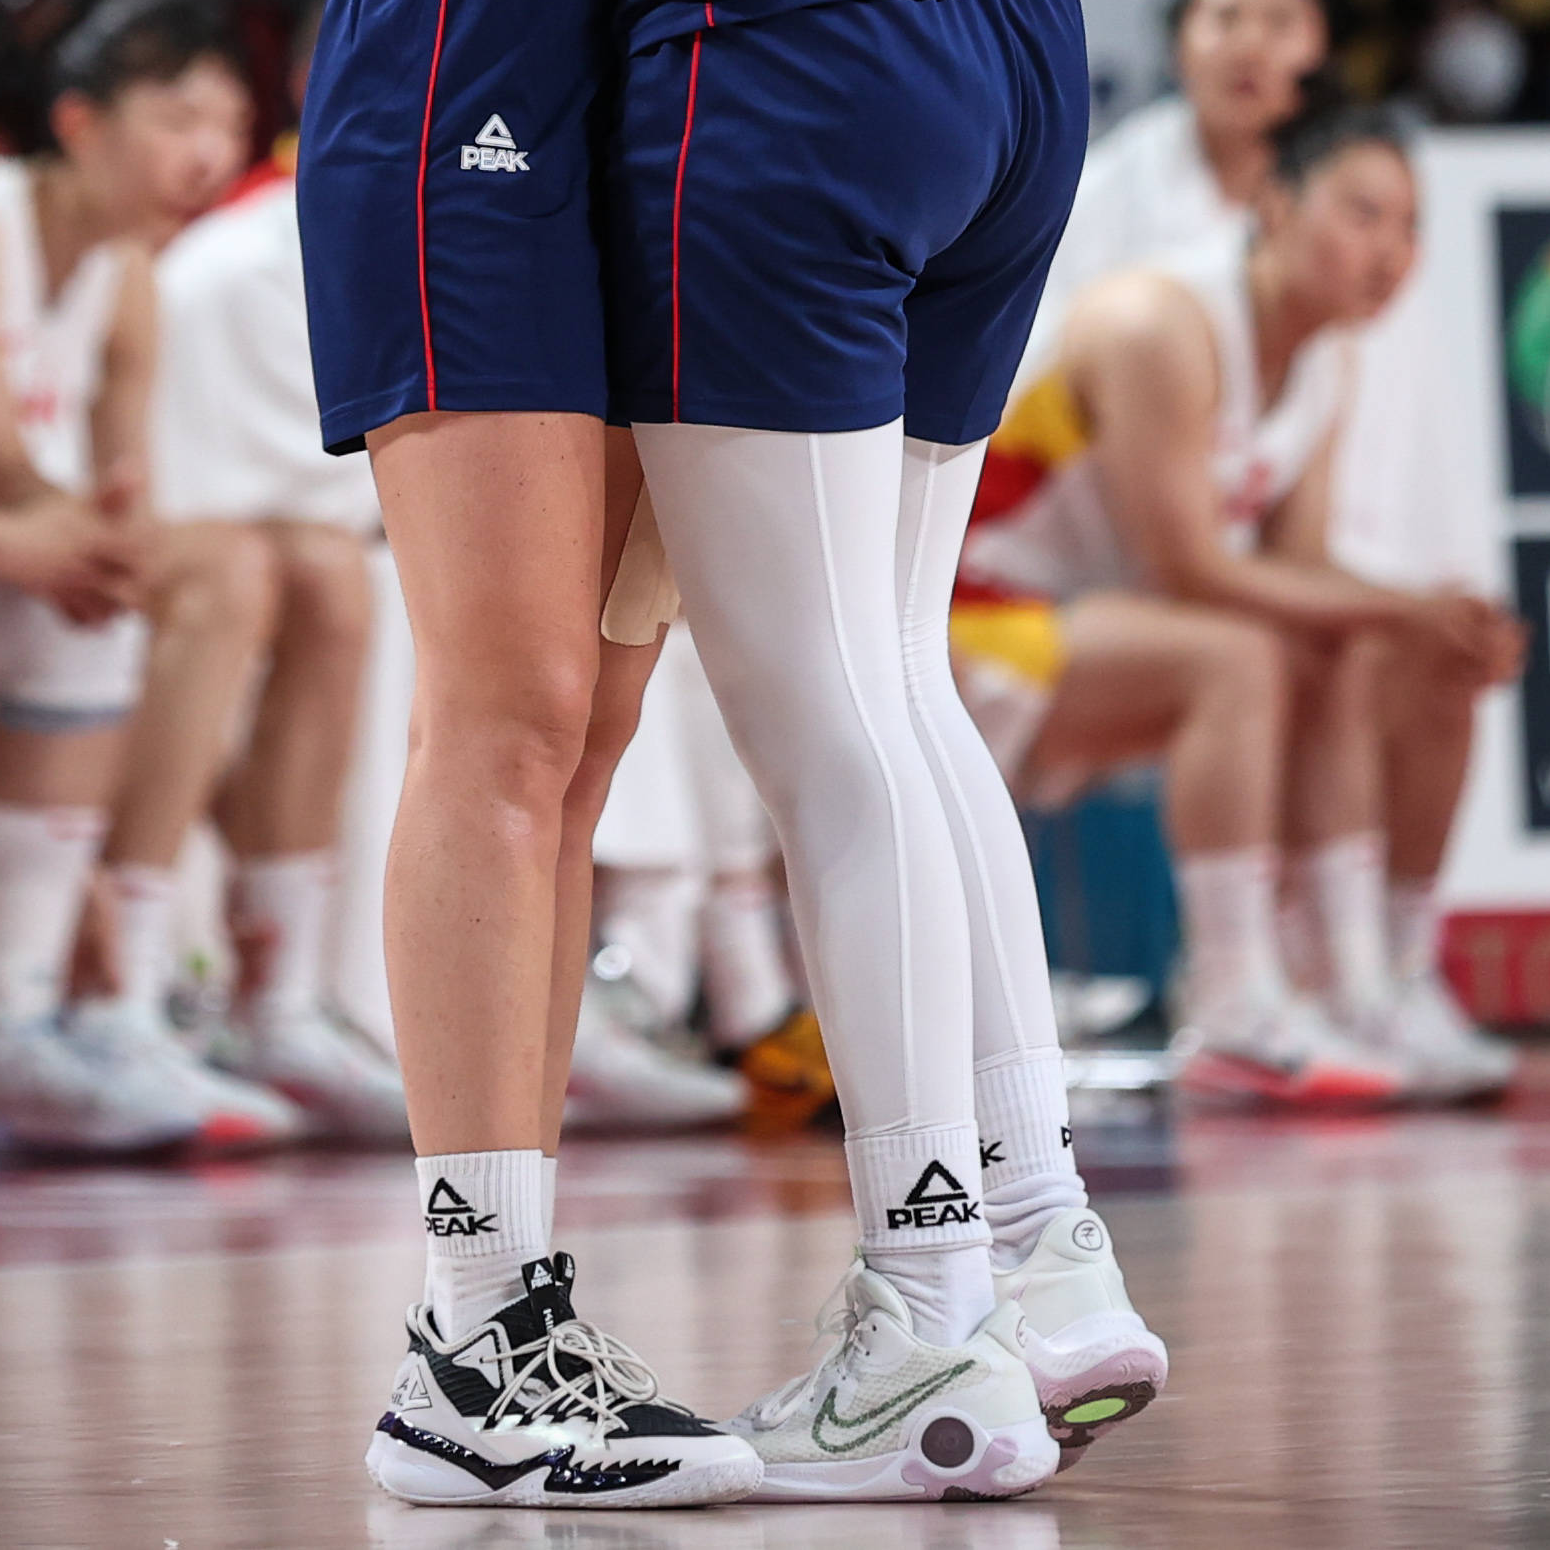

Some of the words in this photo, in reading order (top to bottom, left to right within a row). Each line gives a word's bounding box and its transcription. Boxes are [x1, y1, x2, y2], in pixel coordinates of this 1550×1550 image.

[460, 145, 530, 172] PEAK
[425, 1214, 499, 1237] PEAK
[886, 1201, 982, 1230] PEAK
